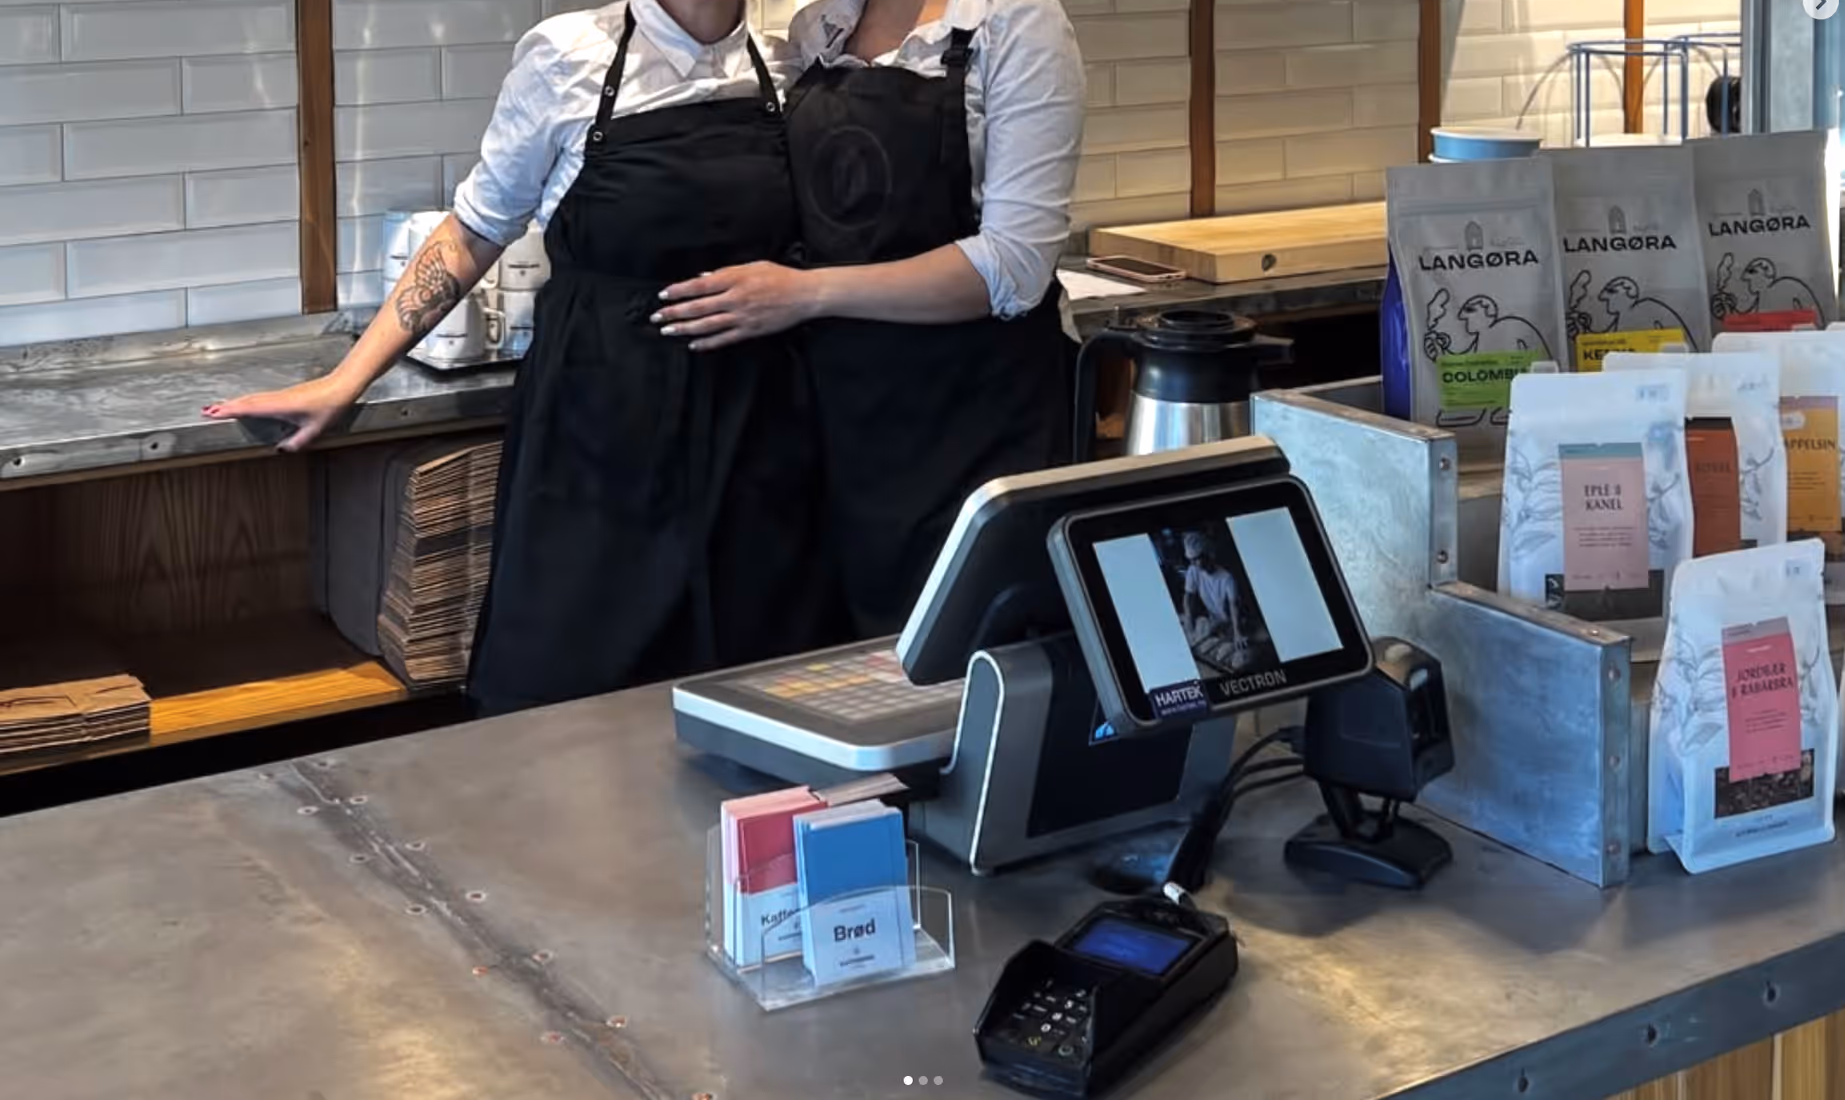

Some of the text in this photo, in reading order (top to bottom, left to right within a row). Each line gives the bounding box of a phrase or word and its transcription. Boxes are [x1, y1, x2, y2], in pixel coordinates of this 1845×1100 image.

[1708, 214, 1810, 237] LANGØRA
[1563, 234, 1677, 253] LANGØRA
[1418, 249, 1539, 271] LANGØRA
[1585, 498, 1624, 511] KANEL
[1219, 669, 1287, 696] VECTRON
[833, 918, 876, 942] Brød
